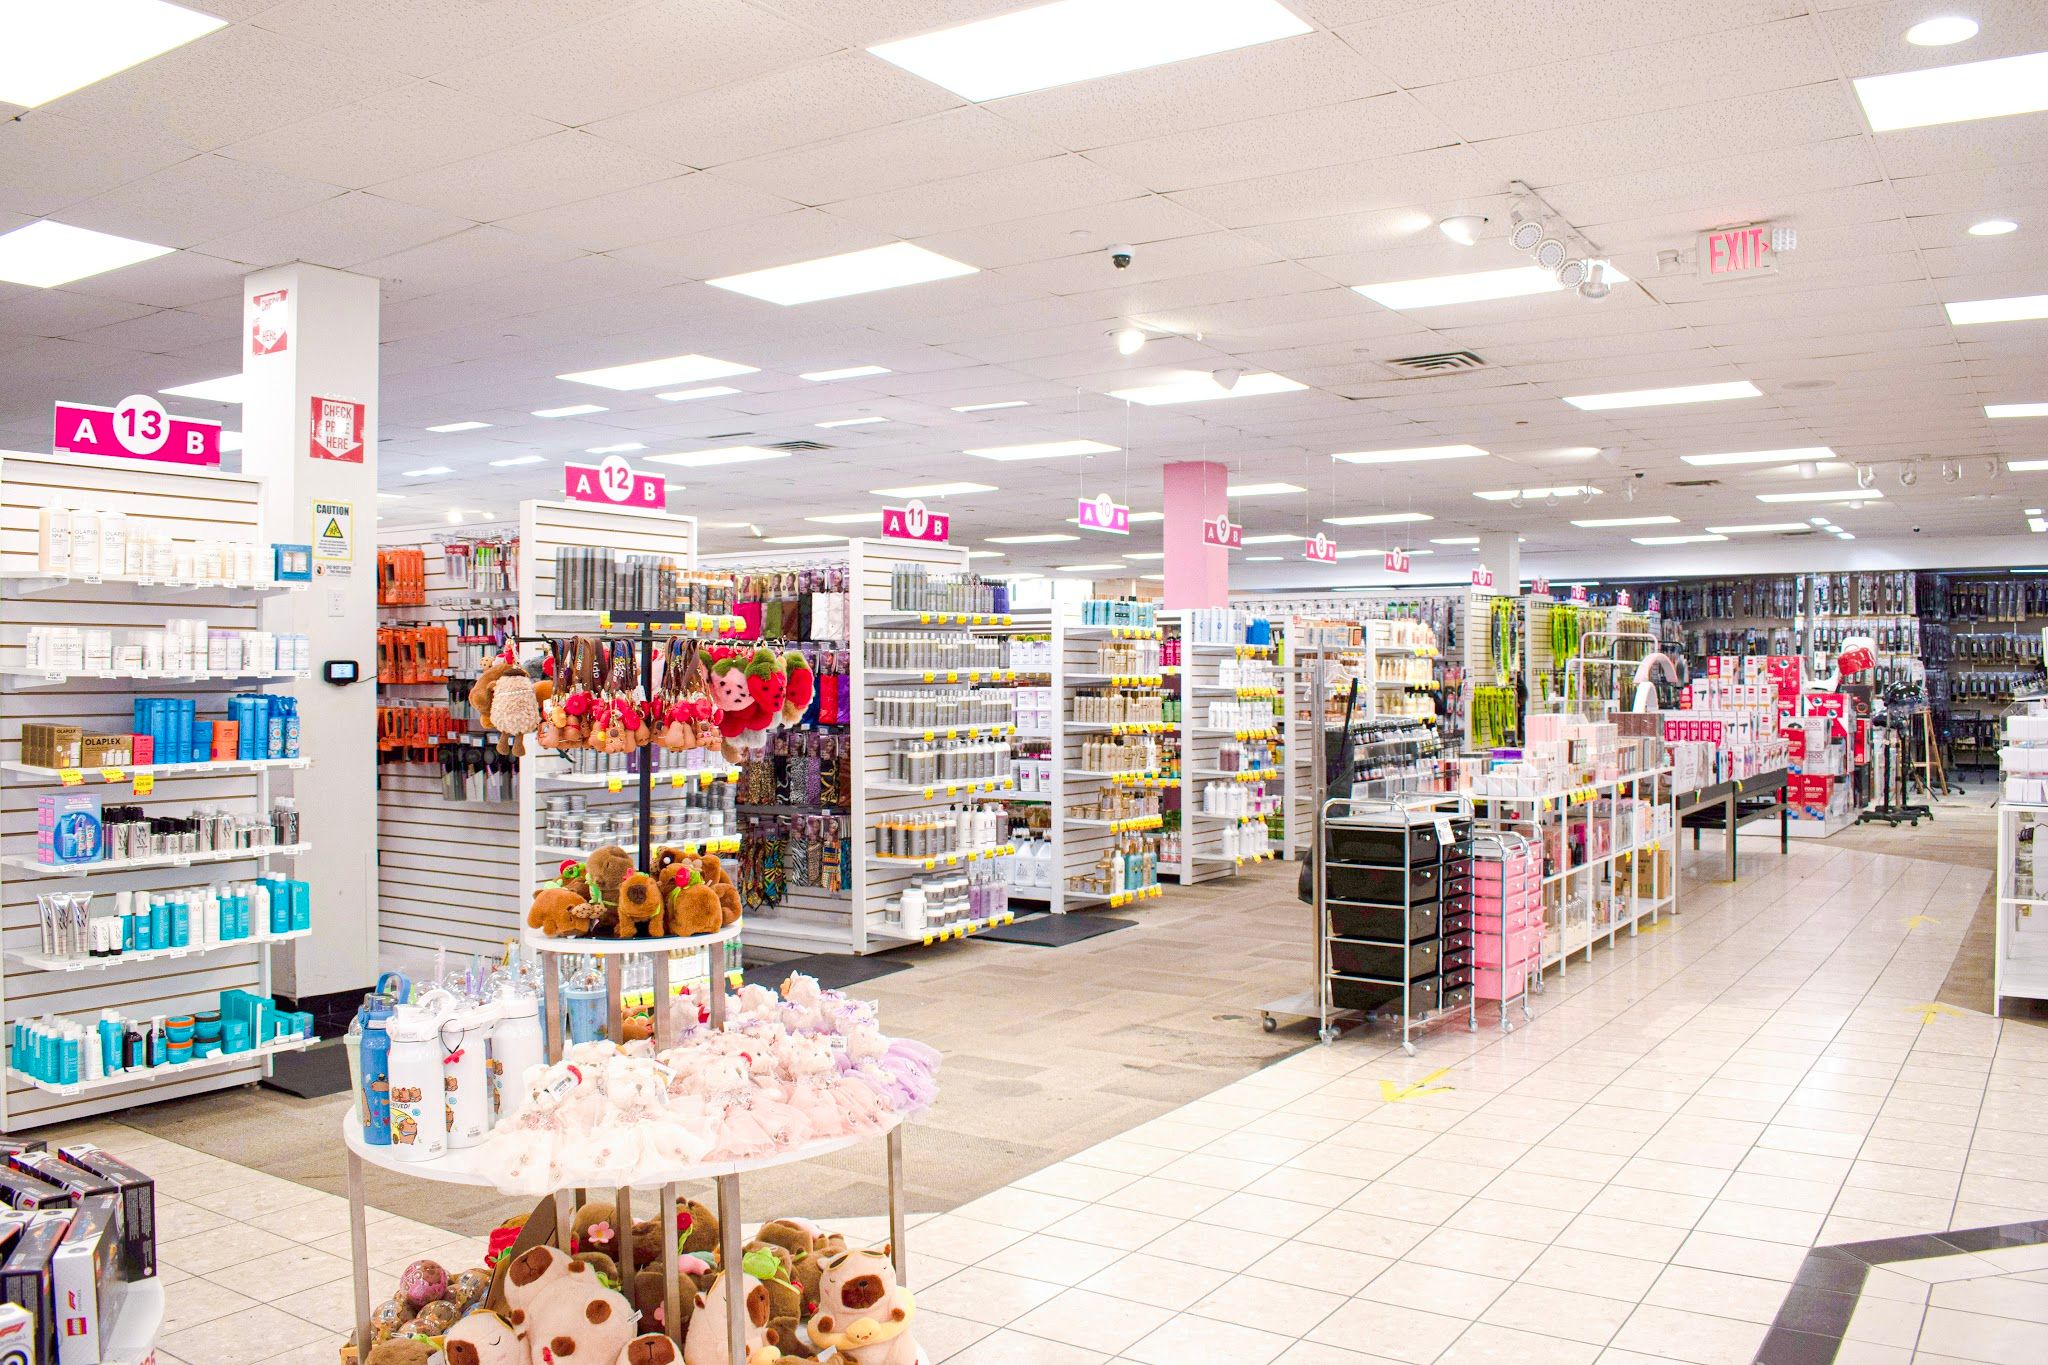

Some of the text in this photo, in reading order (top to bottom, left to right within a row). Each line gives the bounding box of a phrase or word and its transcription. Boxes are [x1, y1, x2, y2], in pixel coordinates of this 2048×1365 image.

[1709, 228, 1763, 275] EXIT
[323, 404, 352, 420] CHECK
[73, 409, 205, 455] A 13 B
[325, 420, 351, 435] PRE
[326, 436, 349, 450] HERE
[576, 466, 656, 501] A 12 B
[316, 504, 350, 516] CAUTION
[1084, 507, 1093, 521] A
[889, 508, 943, 536] A 11 B
[1220, 520, 1227, 537] 9
[84, 738, 121, 746] OLAPLEX
